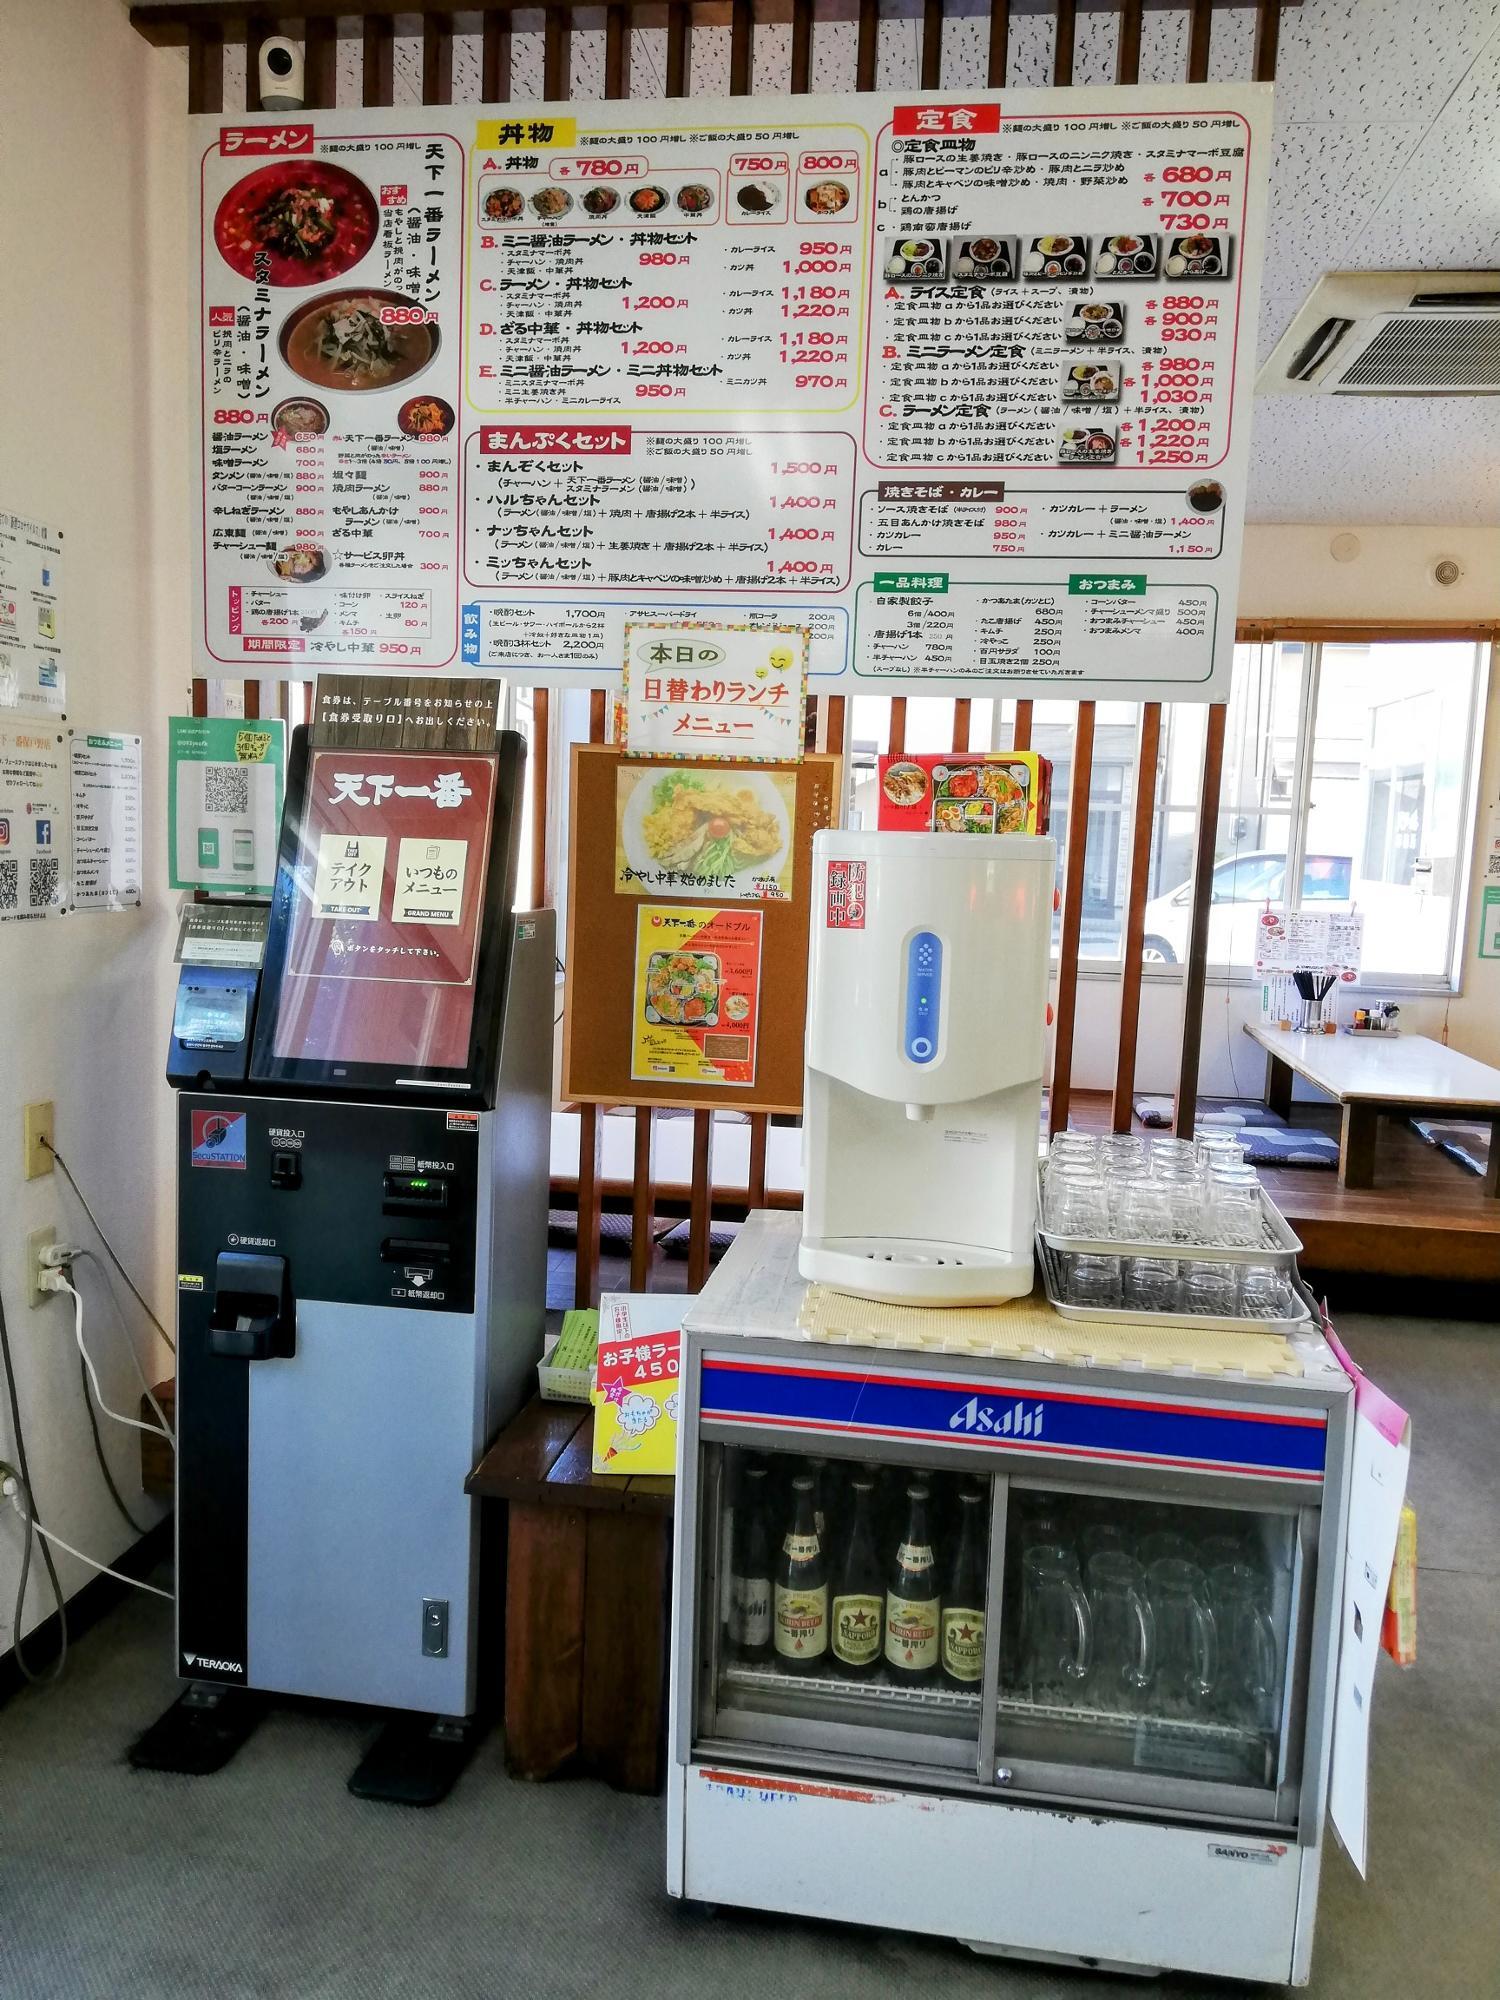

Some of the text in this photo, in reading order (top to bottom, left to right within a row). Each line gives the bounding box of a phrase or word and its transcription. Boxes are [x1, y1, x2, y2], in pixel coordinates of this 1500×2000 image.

[916, 109, 977, 130] 定食
[499, 122, 554, 145] 丼物
[225, 131, 309, 151] ラーメン
[506, 156, 539, 170] 丼物
[735, 158, 787, 171] 750円
[804, 156, 856, 169] 800円
[901, 194, 941, 202] とんかつ
[424, 143, 445, 302] 天下一番ラーメン
[1160, 214, 1228, 230] 730円
[800, 242, 852, 255] 950円
[639, 253, 690, 266] 980円
[783, 260, 851, 274] 1,000円
[500, 276, 632, 291] ラーメン・丼物セット
[781, 286, 850, 300] 1,180円
[910, 285, 986, 299] ライス定食
[622, 296, 689, 312] 1,200円
[781, 304, 849, 318] 1,220円
[380, 307, 438, 324] 880円
[254, 252, 271, 398] スタミナラーメン
[500, 321, 643, 335] ざる中華・丼物セット
[780, 332, 848, 346] 1,180円
[1161, 328, 1216, 341] 930円
[620, 341, 687, 356] 1,200円
[907, 345, 1026, 358] ミニラーメン定食
[779, 350, 847, 364] 1,220円
[795, 375, 847, 388] 970円
[635, 384, 686, 398] 950円
[1141, 390, 1213, 404] 1,030円
[213, 409, 269, 424] 880円
[903, 404, 991, 418] ラーメン定食
[212, 432, 268, 442] 醤油ラーメン
[488, 432, 626, 450] まんぷくセット
[212, 446, 257, 454] 塩ラーメン
[212, 458, 268, 467] 味噌ラーメン
[1136, 451, 1208, 464] 1,250円
[487, 460, 837, 475] まんぞくセット 1,500円
[296, 472, 324, 480] 880円
[419, 471, 448, 479] 900円
[212, 484, 287, 492] バターコーンラーメン
[419, 484, 448, 492] 880円
[884, 485, 998, 498] 焼きそば・カレー
[487, 494, 836, 509] ハルちゃんセット 1,400円
[419, 507, 448, 515] 900円
[878, 505, 1028, 514] ソース焼きそば 900円
[346, 518, 380, 526] ラーメン
[994, 520, 1027, 528] 980円
[1171, 517, 1215, 526] 1,400円
[296, 529, 324, 537] 900円
[332, 529, 373, 538] ざる中華
[487, 525, 834, 541] ナッちゃんセット 1,400円
[993, 532, 1025, 540] 950円
[486, 556, 833, 574] ミッちゃんセット 1,400円
[880, 577, 1136, 590] 一品料理 おつまみ
[877, 597, 933, 606] 自家製餃子
[231, 591, 240, 632] トッピング
[493, 608, 605, 618] 晩酌セット 1,700円
[464, 613, 478, 654] 飲み物
[1176, 628, 1204, 636] 400円
[247, 639, 301, 650] 期間限定
[379, 643, 421, 655] 950円
[563, 641, 604, 649] 2,200円
[650, 643, 718, 664] 本日の
[645, 678, 789, 705] 日替わりランチ
[673, 713, 754, 734] メニュー
[328, 772, 472, 809] 天下一番
[330, 862, 458, 880] テイク いつもの
[330, 877, 457, 896] アウト メニュー
[330, 905, 346, 913] TAKE
[949, 1397, 1043, 1437] Asahi
[196, 1657, 243, 1673] TERAOKA
[1215, 1848, 1248, 1858] SANYO
